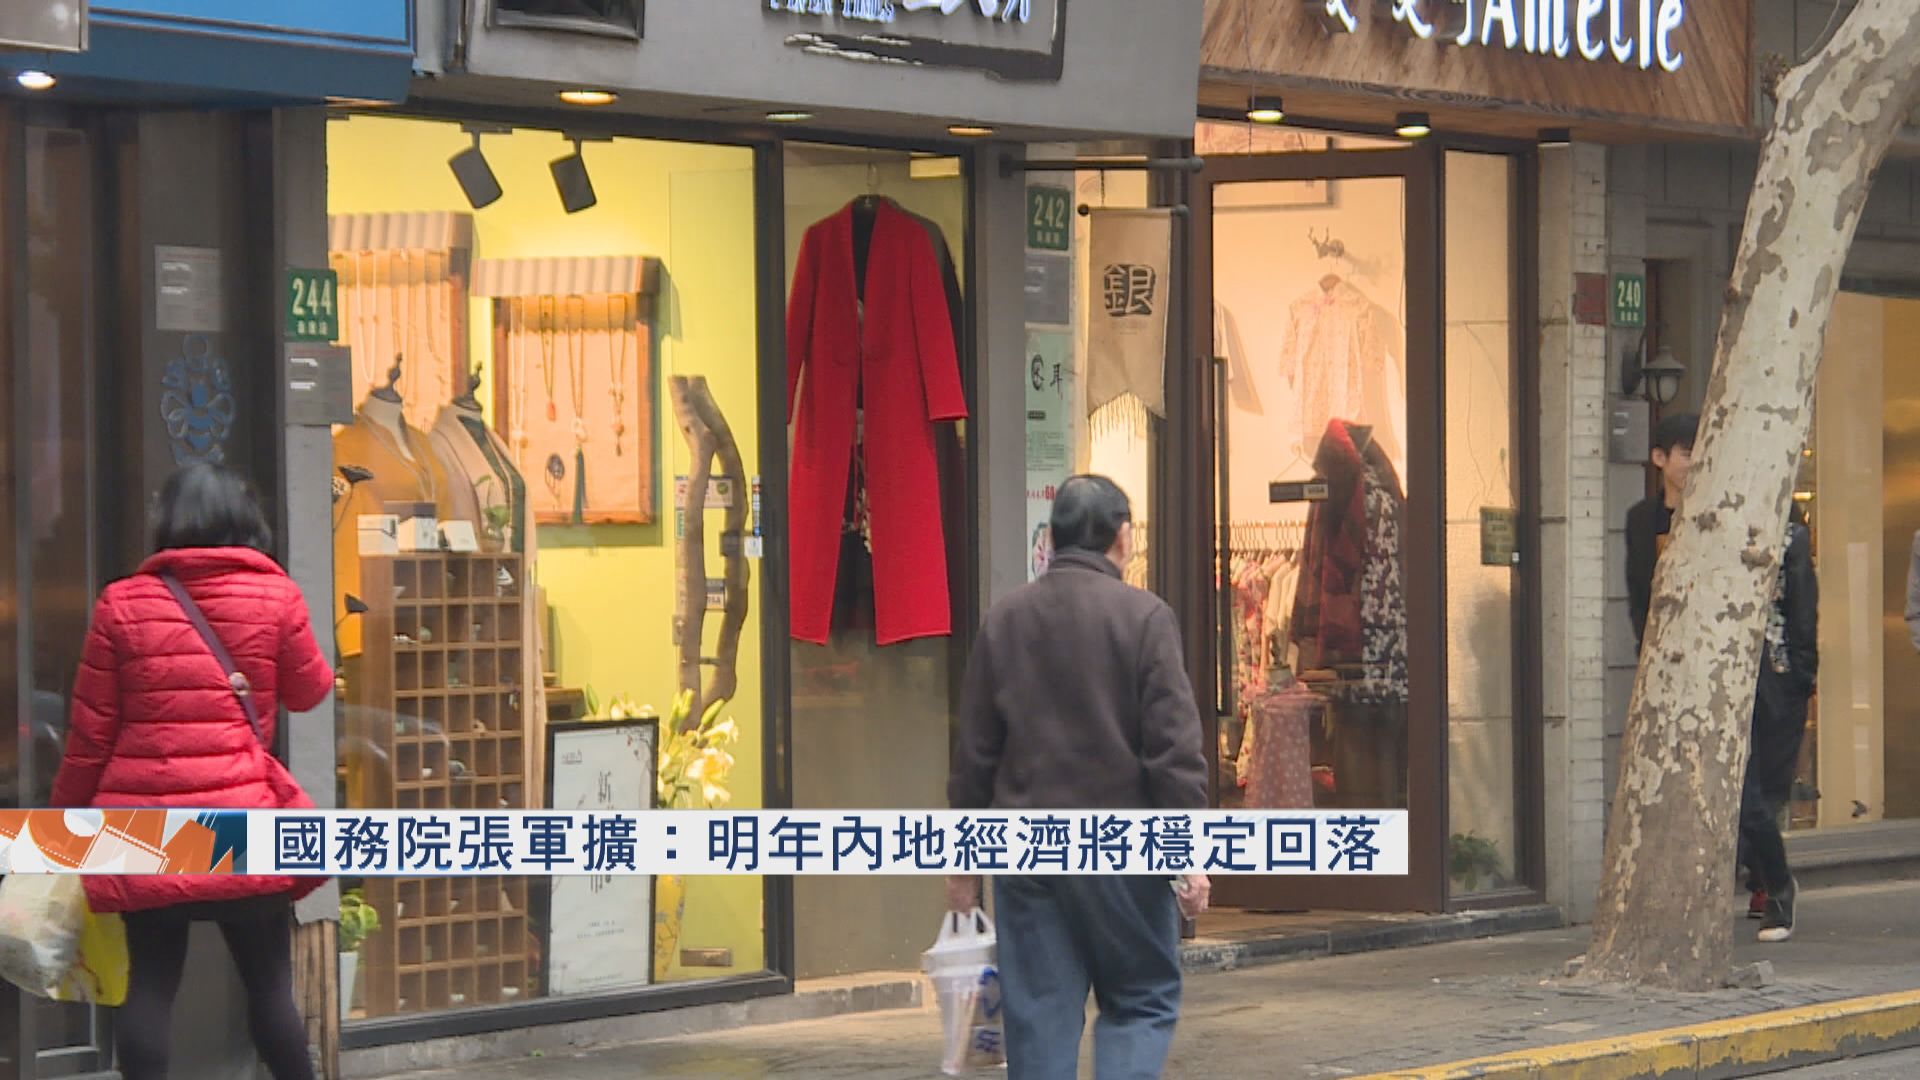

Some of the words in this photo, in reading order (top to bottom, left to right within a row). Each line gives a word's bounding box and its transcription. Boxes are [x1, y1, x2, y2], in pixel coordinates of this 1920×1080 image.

[1034, 194, 1065, 229] 242
[292, 277, 332, 316] 244
[1104, 264, 1157, 317] 銀
[1618, 279, 1641, 308] 240
